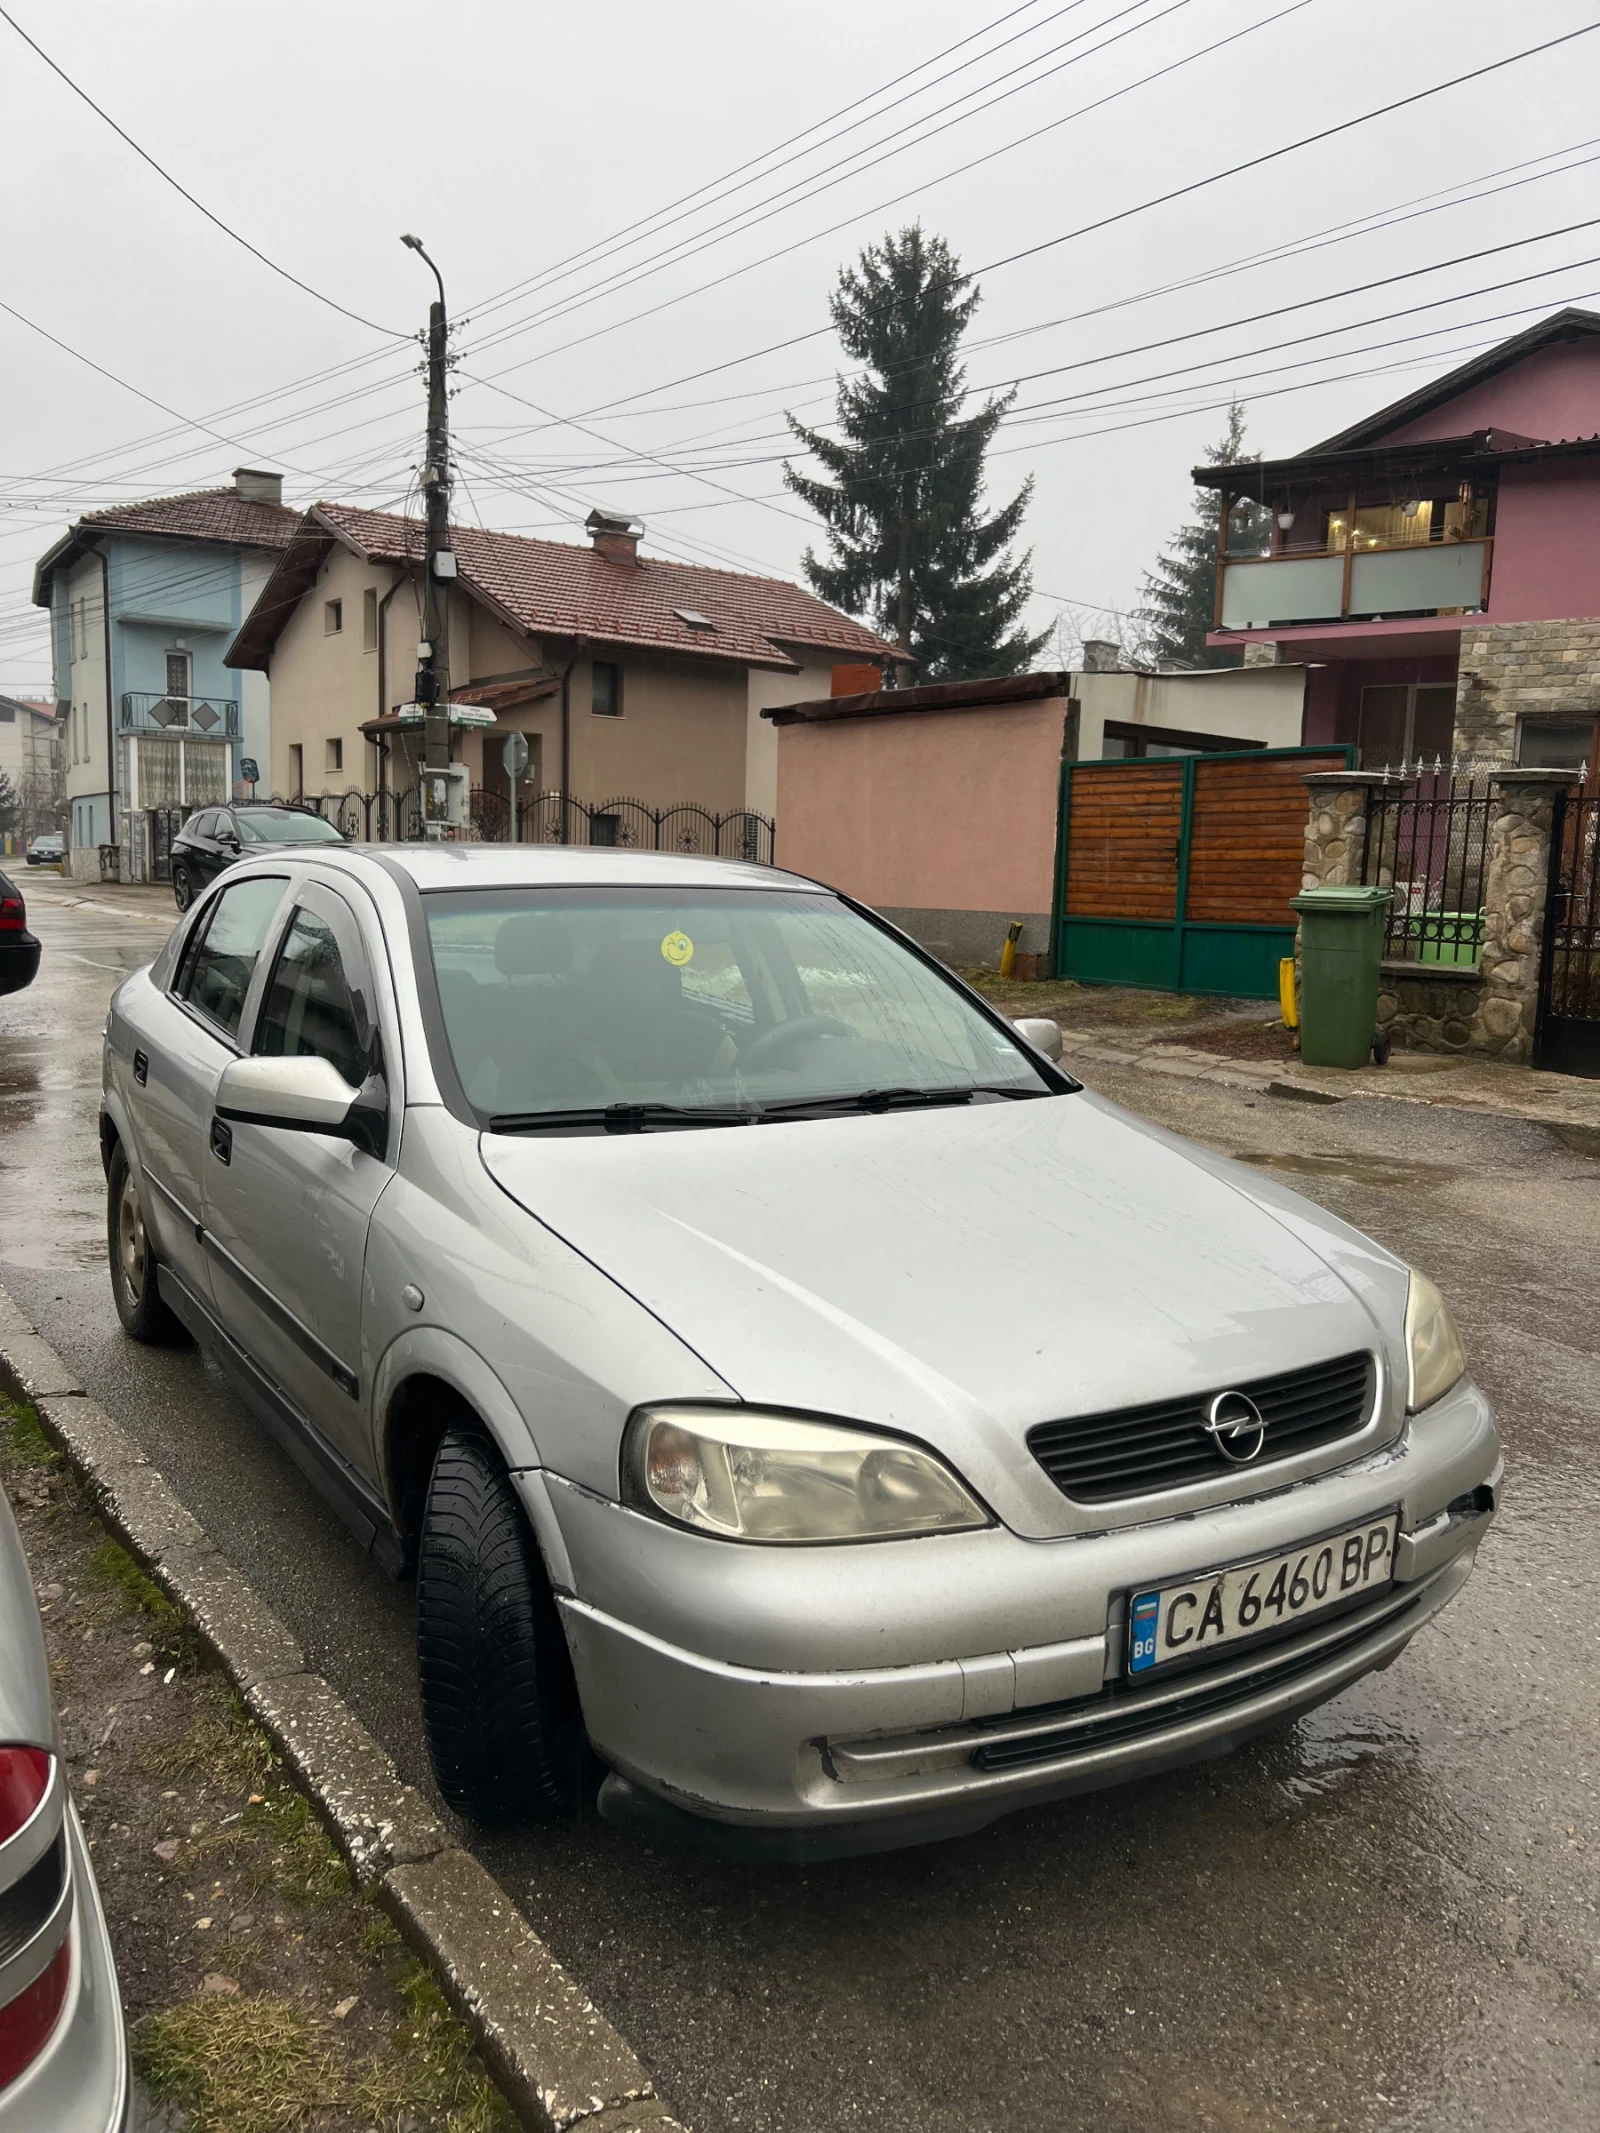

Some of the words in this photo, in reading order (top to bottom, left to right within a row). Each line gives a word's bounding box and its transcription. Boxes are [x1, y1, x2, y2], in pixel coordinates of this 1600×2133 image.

[1165, 1583, 1224, 1648] CA
[1238, 1547, 1333, 1628] 6460
[1340, 1525, 1389, 1592] BP
[1134, 1638, 1154, 1659] BG
